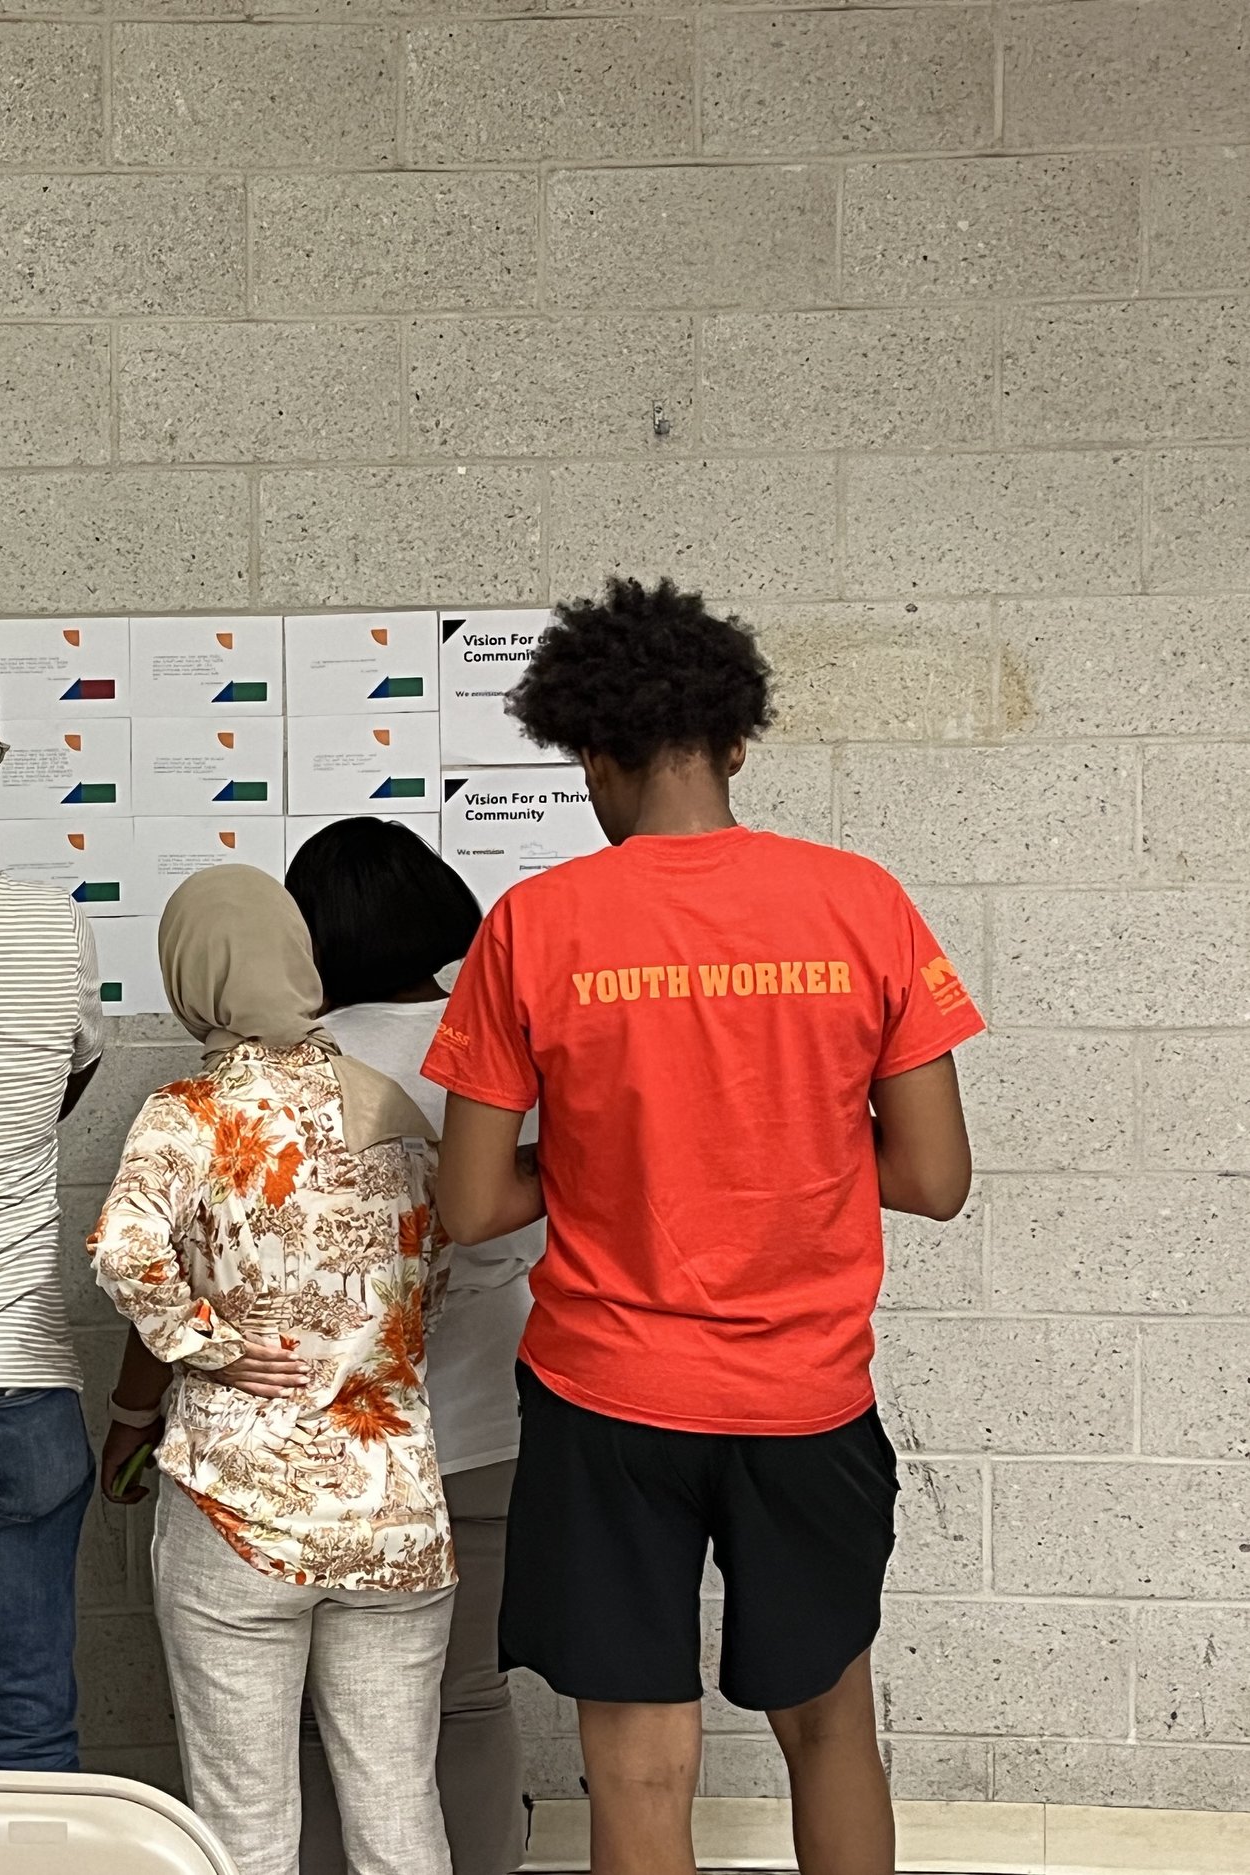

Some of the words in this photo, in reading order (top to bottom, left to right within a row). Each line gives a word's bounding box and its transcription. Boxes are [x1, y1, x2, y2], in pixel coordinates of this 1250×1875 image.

[463, 633, 506, 646] Vision
[510, 633, 534, 645] For
[463, 649, 530, 662] Communi
[464, 793, 508, 806] Vision
[511, 793, 535, 804] For
[538, 794, 548, 804] a
[551, 791, 590, 803] Thriv
[465, 808, 545, 822] Community
[572, 965, 689, 1005] YOUTH
[698, 960, 852, 997] WORKER
